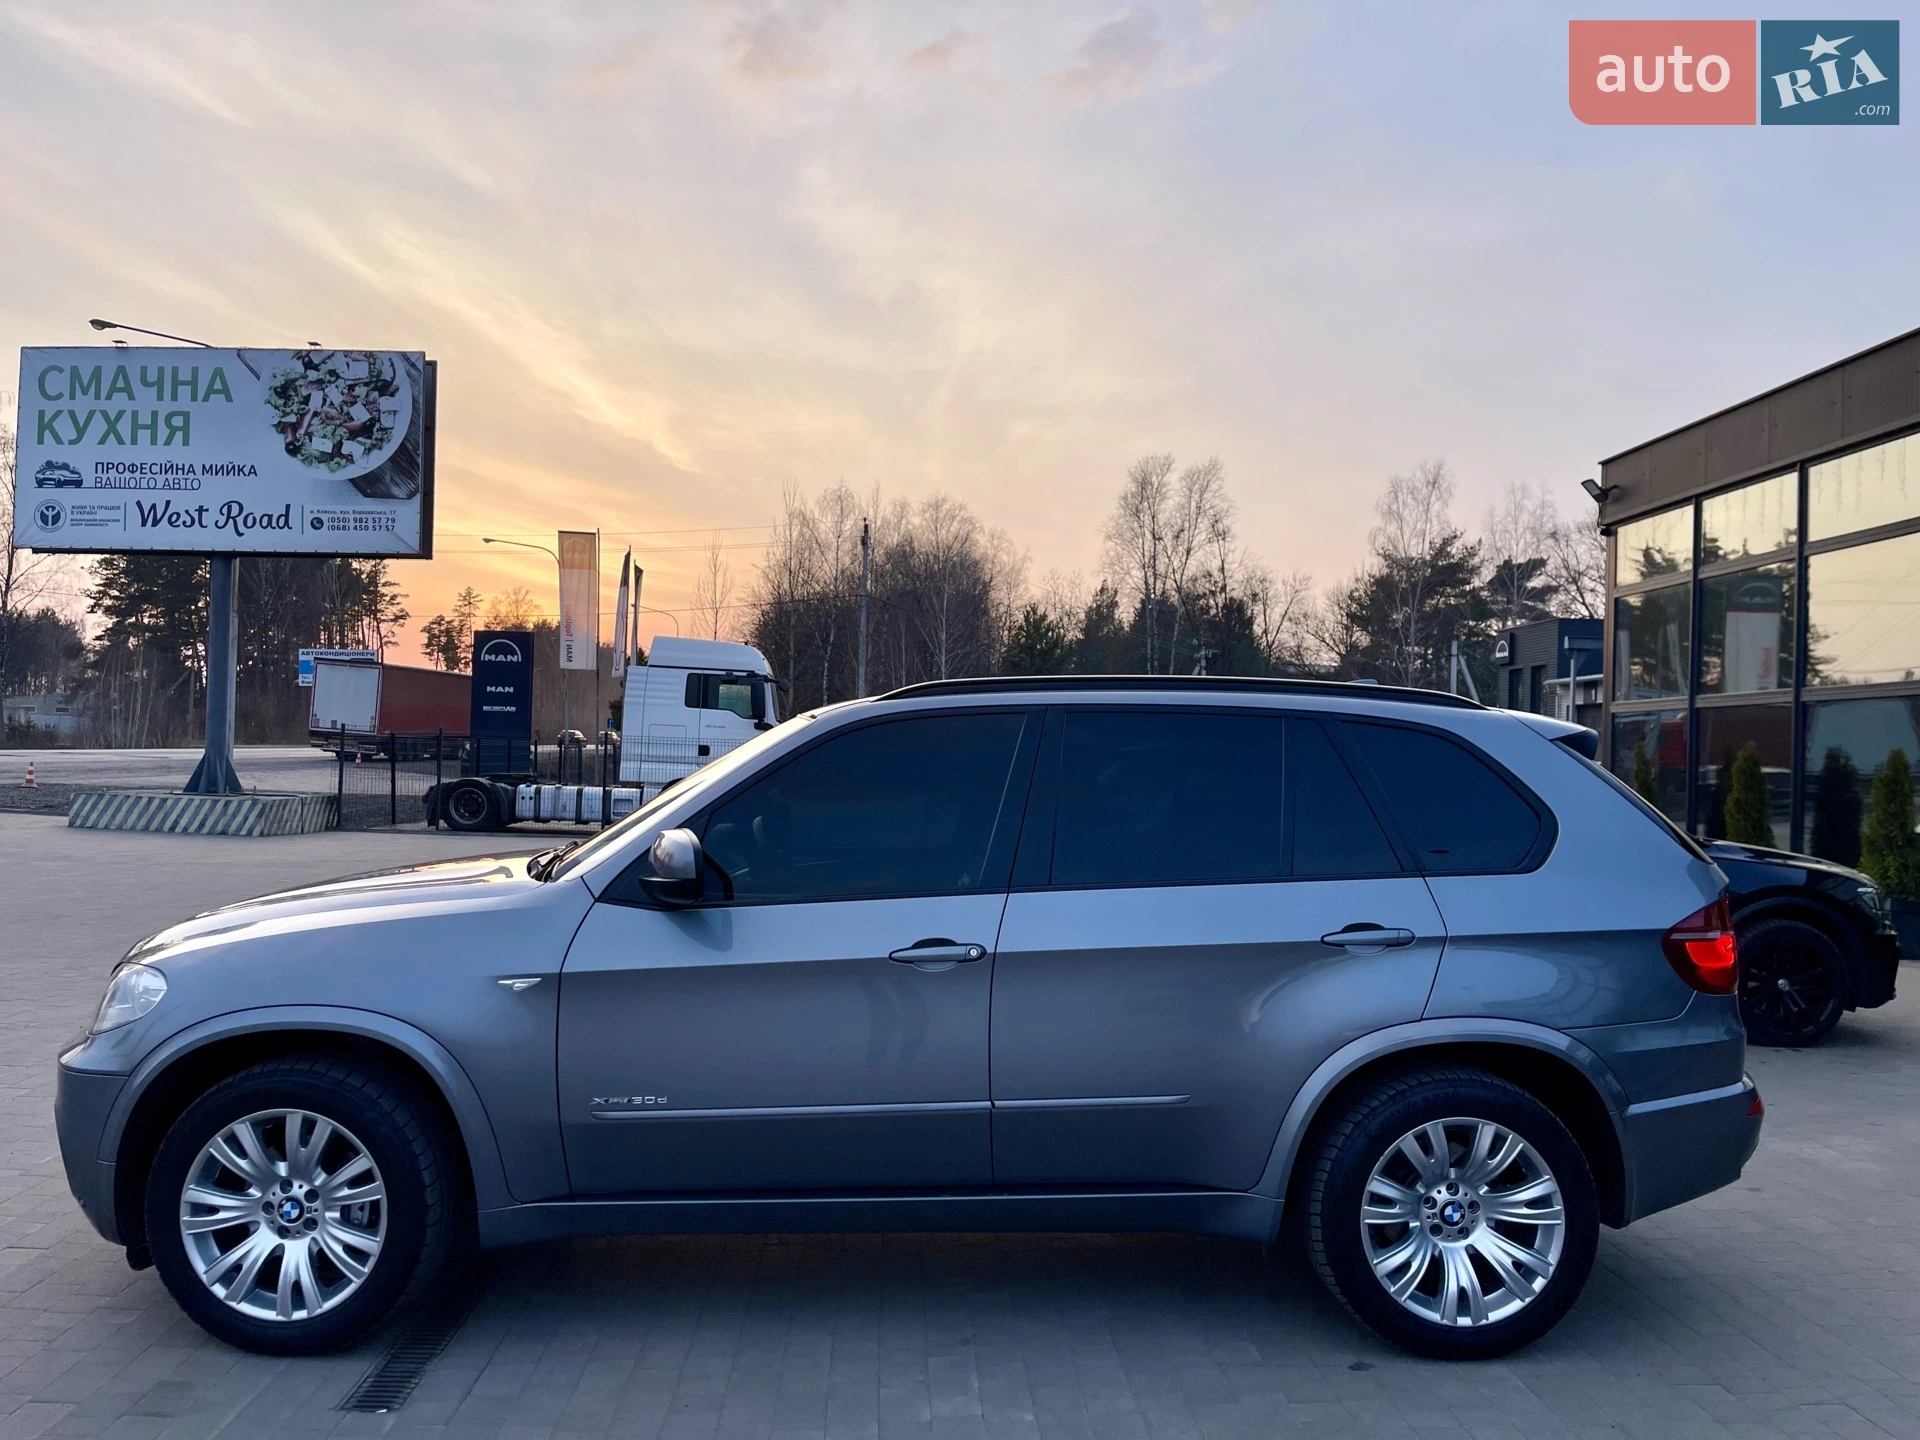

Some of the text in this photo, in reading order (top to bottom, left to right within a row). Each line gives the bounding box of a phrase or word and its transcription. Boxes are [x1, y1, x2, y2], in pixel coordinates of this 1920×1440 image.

[37, 364, 234, 403] СМАЧНА
[36, 409, 191, 447] КУХНЯ
[94, 460, 258, 478] ПРОФЕСІЙНА МИЙКА
[94, 476, 202, 491] ВАШОГО АВТО
[135, 499, 293, 538] West Road
[327, 516, 351, 524] (050)
[327, 524, 351, 532] (068)
[484, 654, 518, 662] MAN
[486, 685, 514, 693] MAN
